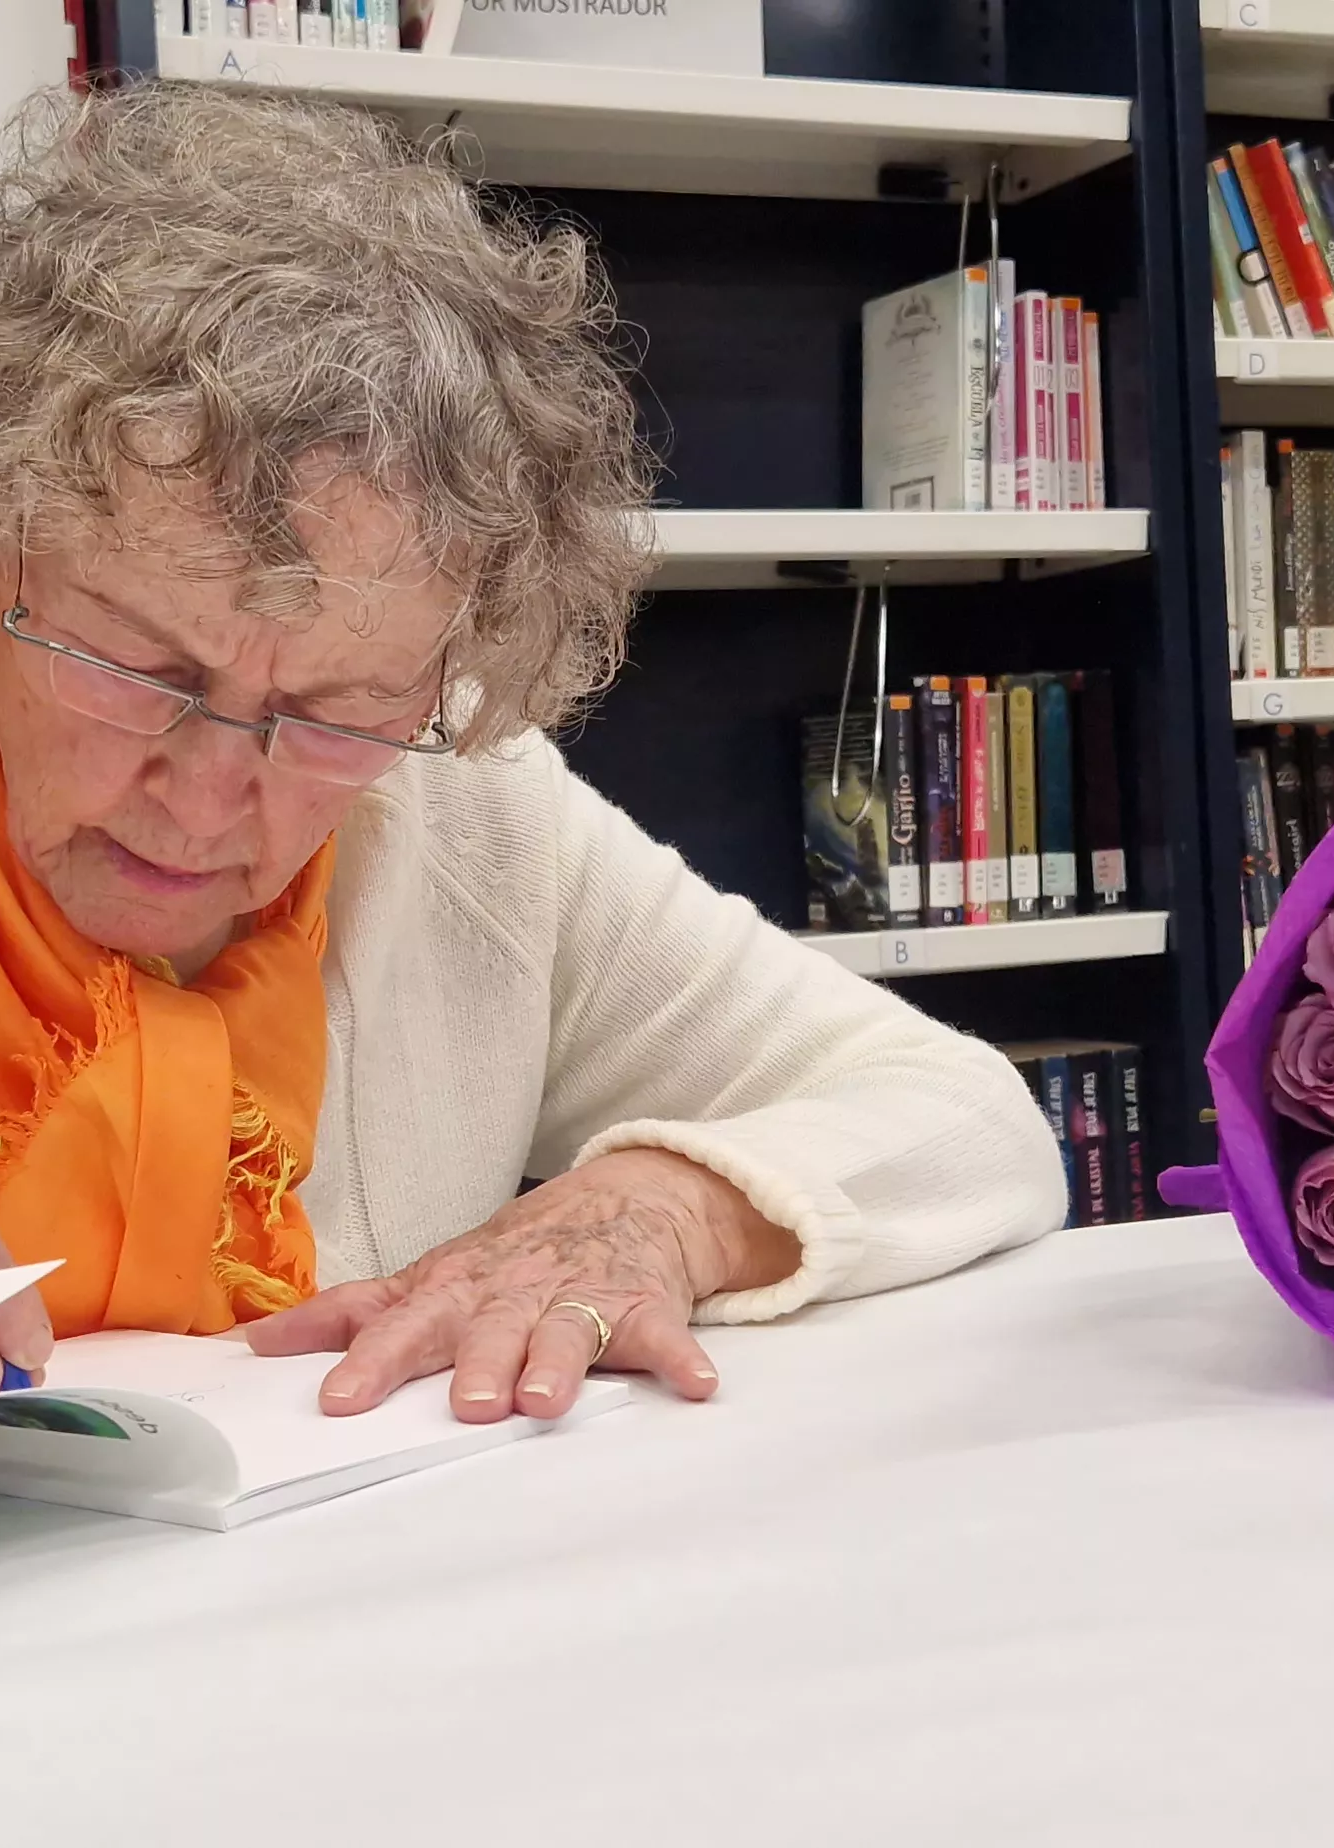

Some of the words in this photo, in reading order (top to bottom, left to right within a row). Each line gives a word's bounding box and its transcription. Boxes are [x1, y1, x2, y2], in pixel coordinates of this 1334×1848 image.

[514, 0, 668, 16] MOSTRADOR
[1240, 4, 1259, 27] C
[220, 50, 242, 76] A
[1249, 353, 1266, 377] D
[967, 364, 985, 429] ESCUELA
[1263, 693, 1284, 716] G
[895, 940, 909, 964] B
[1082, 1071, 1097, 1108] JEANS
[1123, 1067, 1137, 1104] JEANS
[1087, 1146, 1103, 1196] CRISTAL
